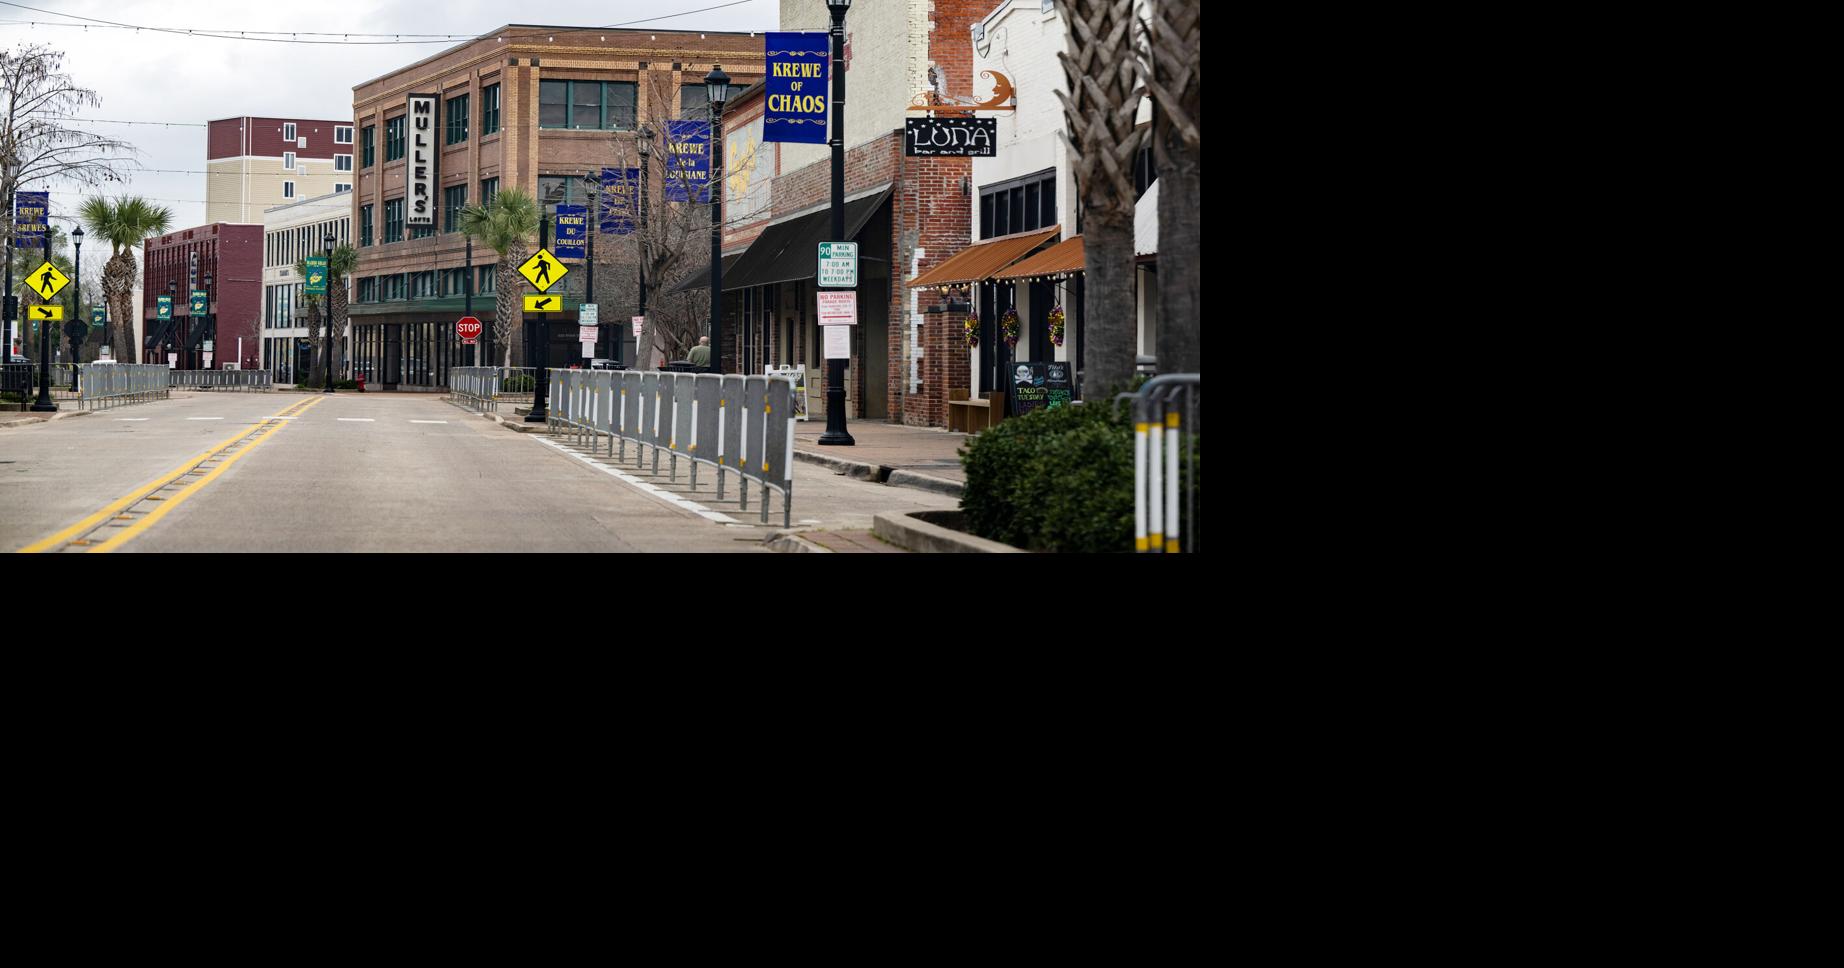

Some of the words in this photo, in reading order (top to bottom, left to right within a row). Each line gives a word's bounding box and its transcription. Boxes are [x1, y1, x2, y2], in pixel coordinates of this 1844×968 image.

[773, 62, 822, 78] KREWE
[791, 81, 804, 92] OF
[768, 94, 826, 114] CHAOS
[913, 127, 991, 146] LUNA
[668, 142, 705, 155] KREWE
[914, 147, 936, 155] bar
[940, 147, 964, 155] and
[968, 147, 991, 156] grill
[604, 185, 635, 195] KREE
[19, 207, 45, 216] KREWE
[559, 216, 584, 225] KREWE
[820, 246, 831, 256] 90
[458, 323, 480, 333] STOP
